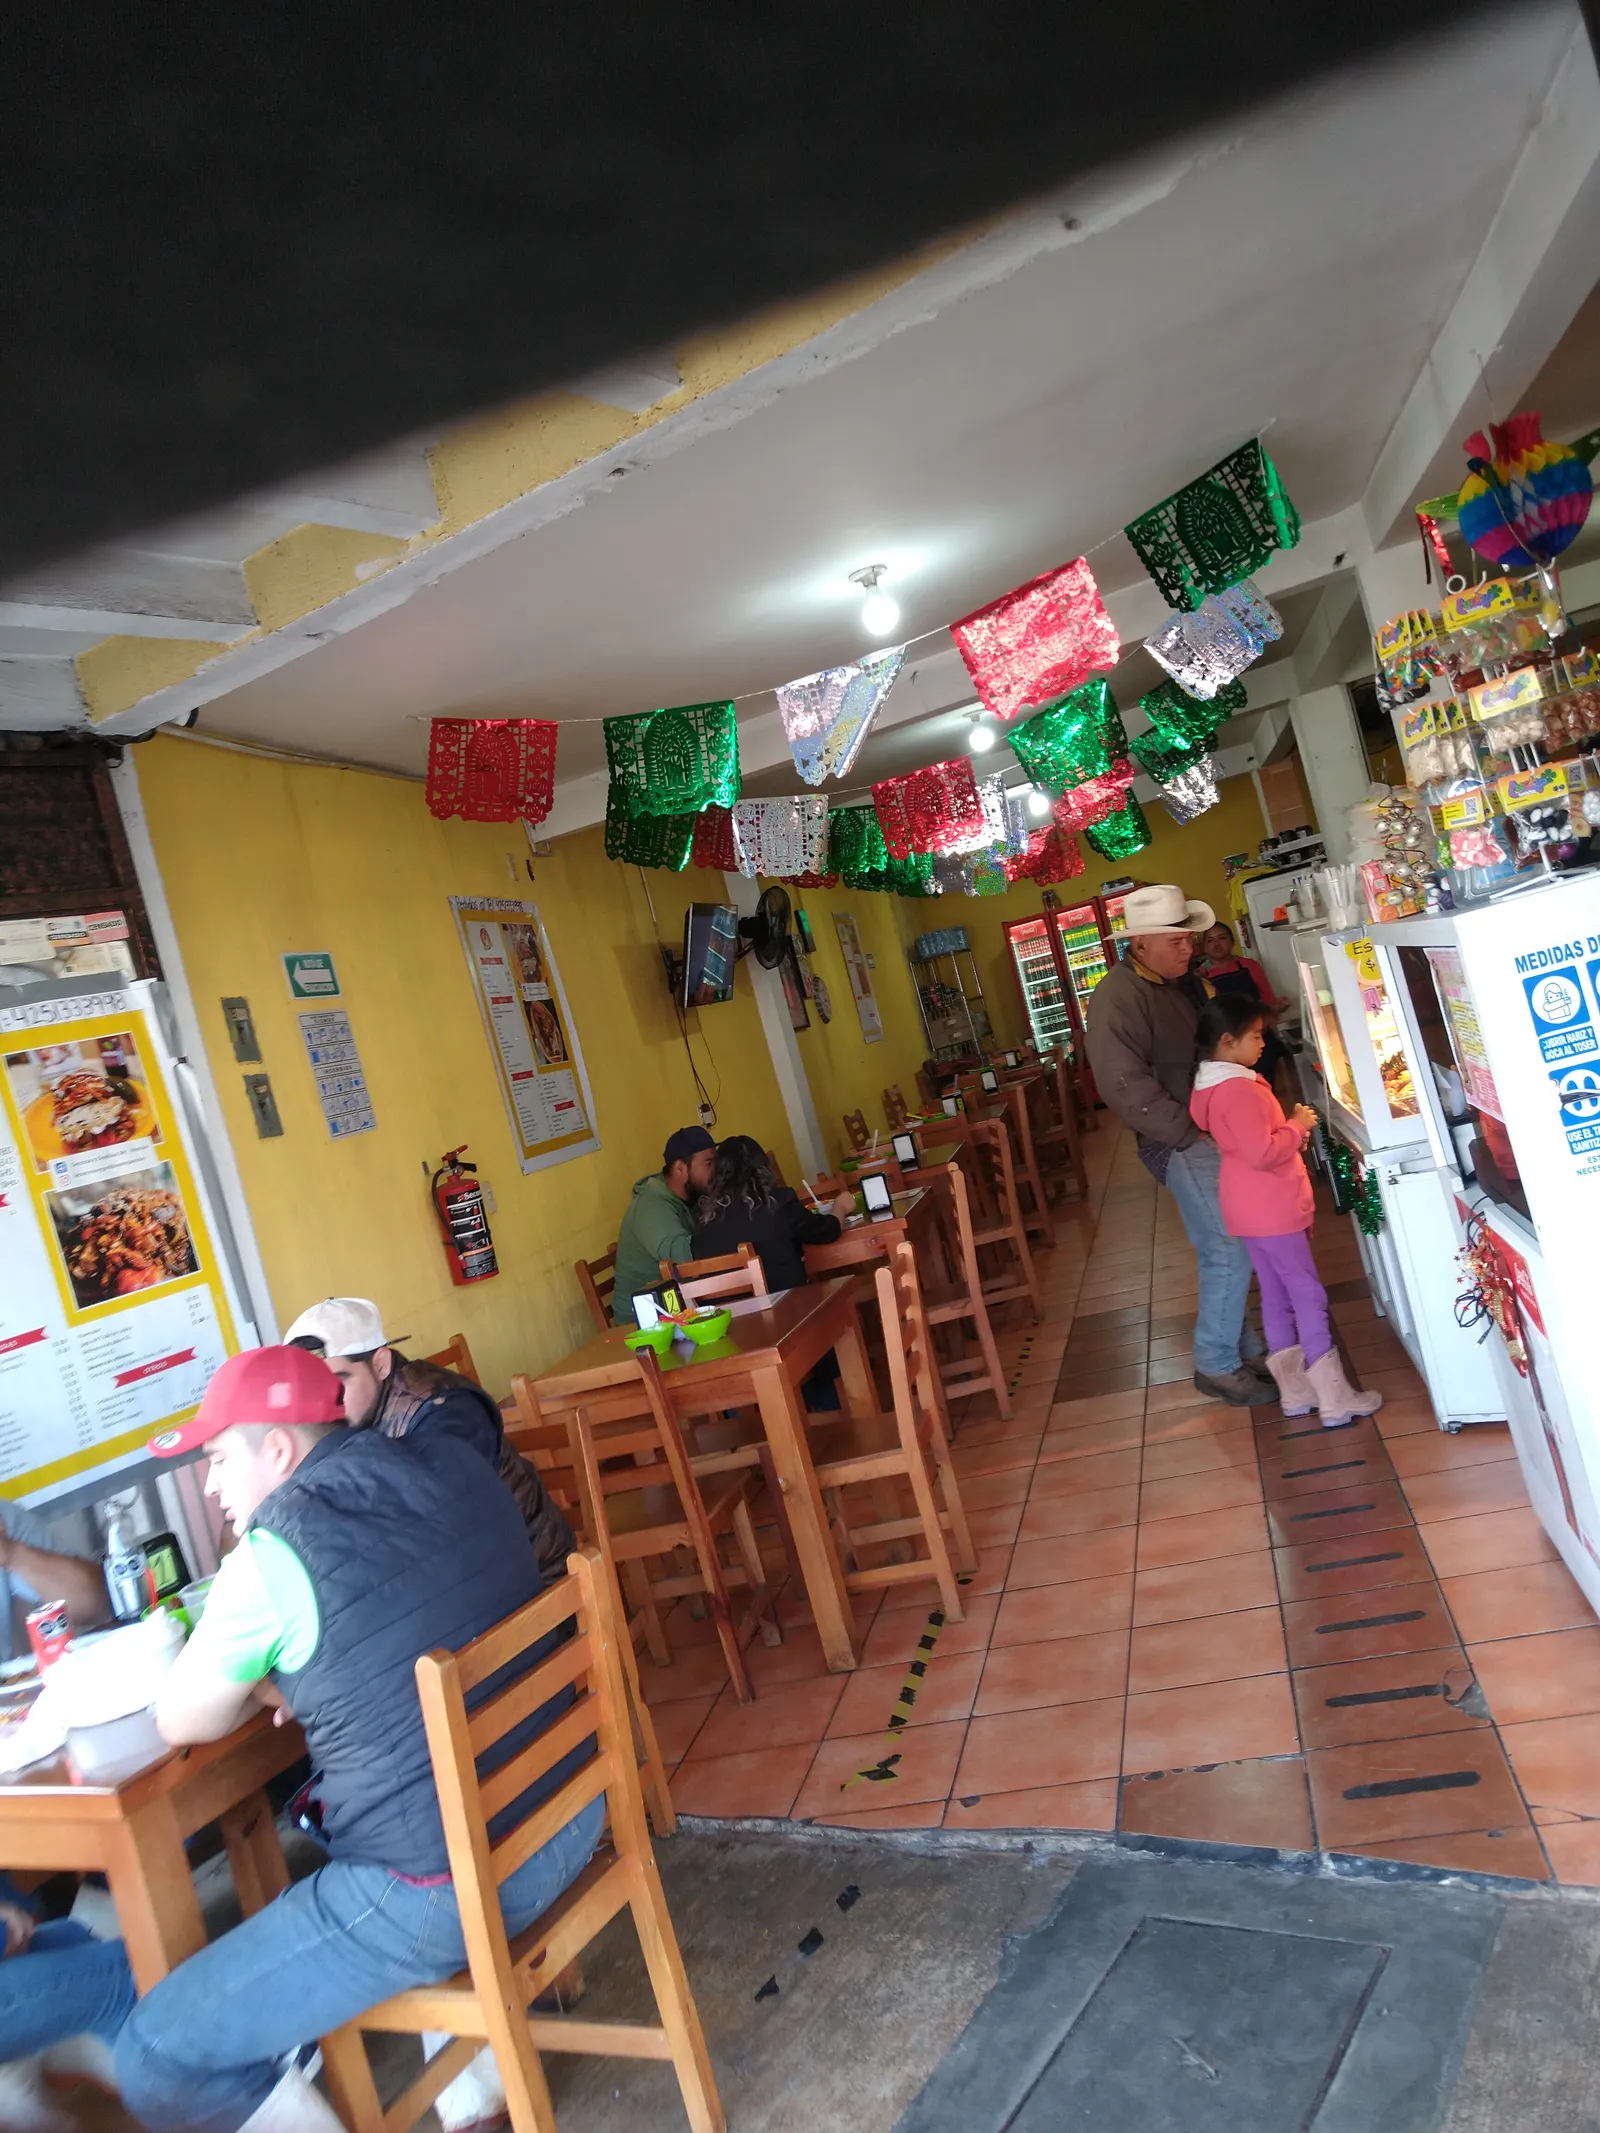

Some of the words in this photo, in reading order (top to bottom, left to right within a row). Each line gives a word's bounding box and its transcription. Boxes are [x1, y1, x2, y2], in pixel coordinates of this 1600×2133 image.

[1514, 940, 1584, 973] MEDIDAS
[1565, 1029, 1588, 1043] NARIZ
[1573, 1039, 1597, 1052] TOSER
[1567, 1130, 1584, 1142] USE
[667, 1293, 679, 1313] 2
